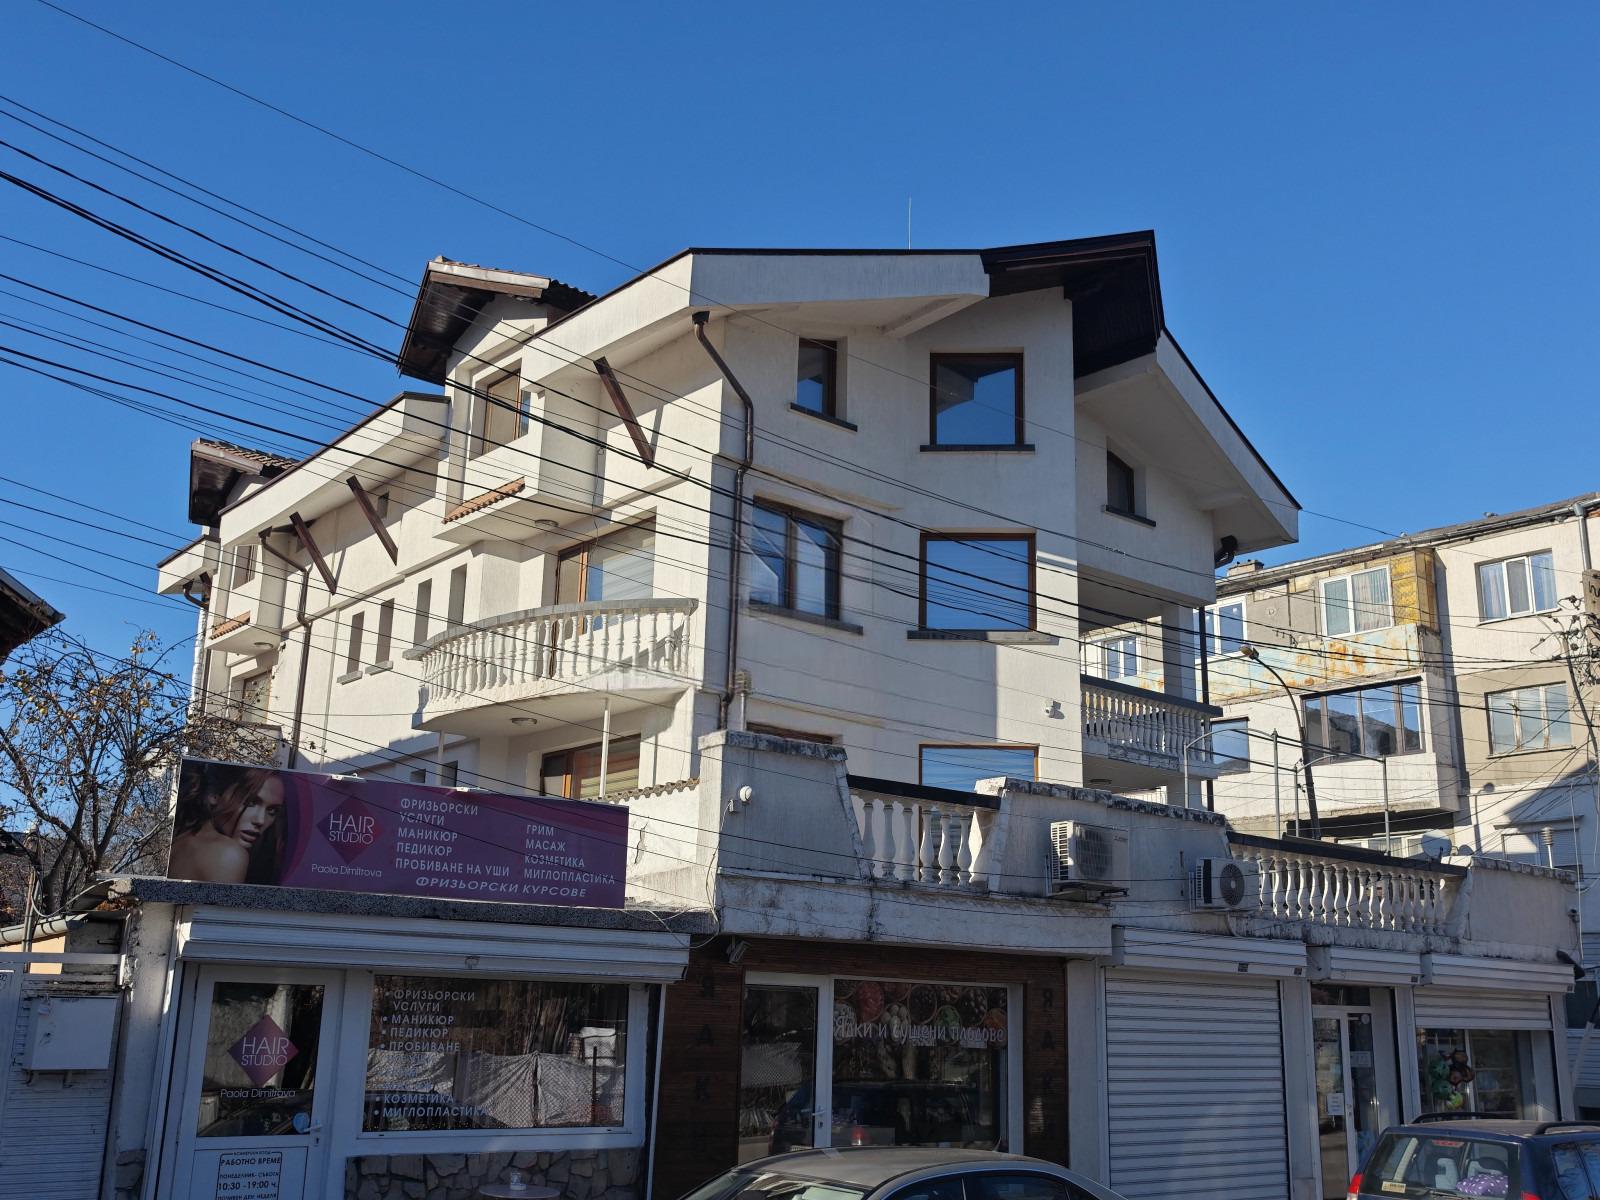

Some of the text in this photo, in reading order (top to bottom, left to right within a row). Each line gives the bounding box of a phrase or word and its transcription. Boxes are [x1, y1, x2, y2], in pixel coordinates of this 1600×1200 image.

[401, 798, 479, 816] ФРИЗЬОРСКИ
[329, 813, 375, 834] HAIR
[400, 812, 445, 826] УСЛУГИ
[397, 827, 458, 843] МАНИКЮР
[526, 824, 554, 836] ГРИМ
[328, 831, 374, 845] STUDIO
[396, 842, 453, 857] ПЕДИКЮР
[525, 839, 566, 852] МАСАЖ
[395, 858, 510, 877] ПРОБИВАНЕ НА УШИ
[524, 854, 585, 868] КОЗМЕТИКА
[311, 864, 382, 878] Paola Dimitrova
[523, 868, 616, 885] МИГЛОПЛАСТИКА
[416, 876, 587, 897] ФРИЗЬОРСКИ КУРСОВЕ
[393, 989, 475, 1001] ФРИЗЬОРСКИ
[393, 1001, 440, 1012] УСЛУГИ
[391, 1014, 454, 1025] МАНИКЮР
[390, 1028, 449, 1038] ПЕДИКЮР
[242, 1036, 289, 1055] HAIR
[389, 1042, 461, 1052] ПРОБИВАНЕ
[241, 1054, 288, 1066] STUDIO
[220, 1088, 296, 1098] Paola Dimitrova
[383, 1093, 454, 1104] КОЗМЕТИКА
[383, 1106, 489, 1118] МИГЛОПЛАСТИКА
[220, 1156, 280, 1166] РАБОТНО ВРЕМЕ
[218, 1181, 240, 1191] 10:30
